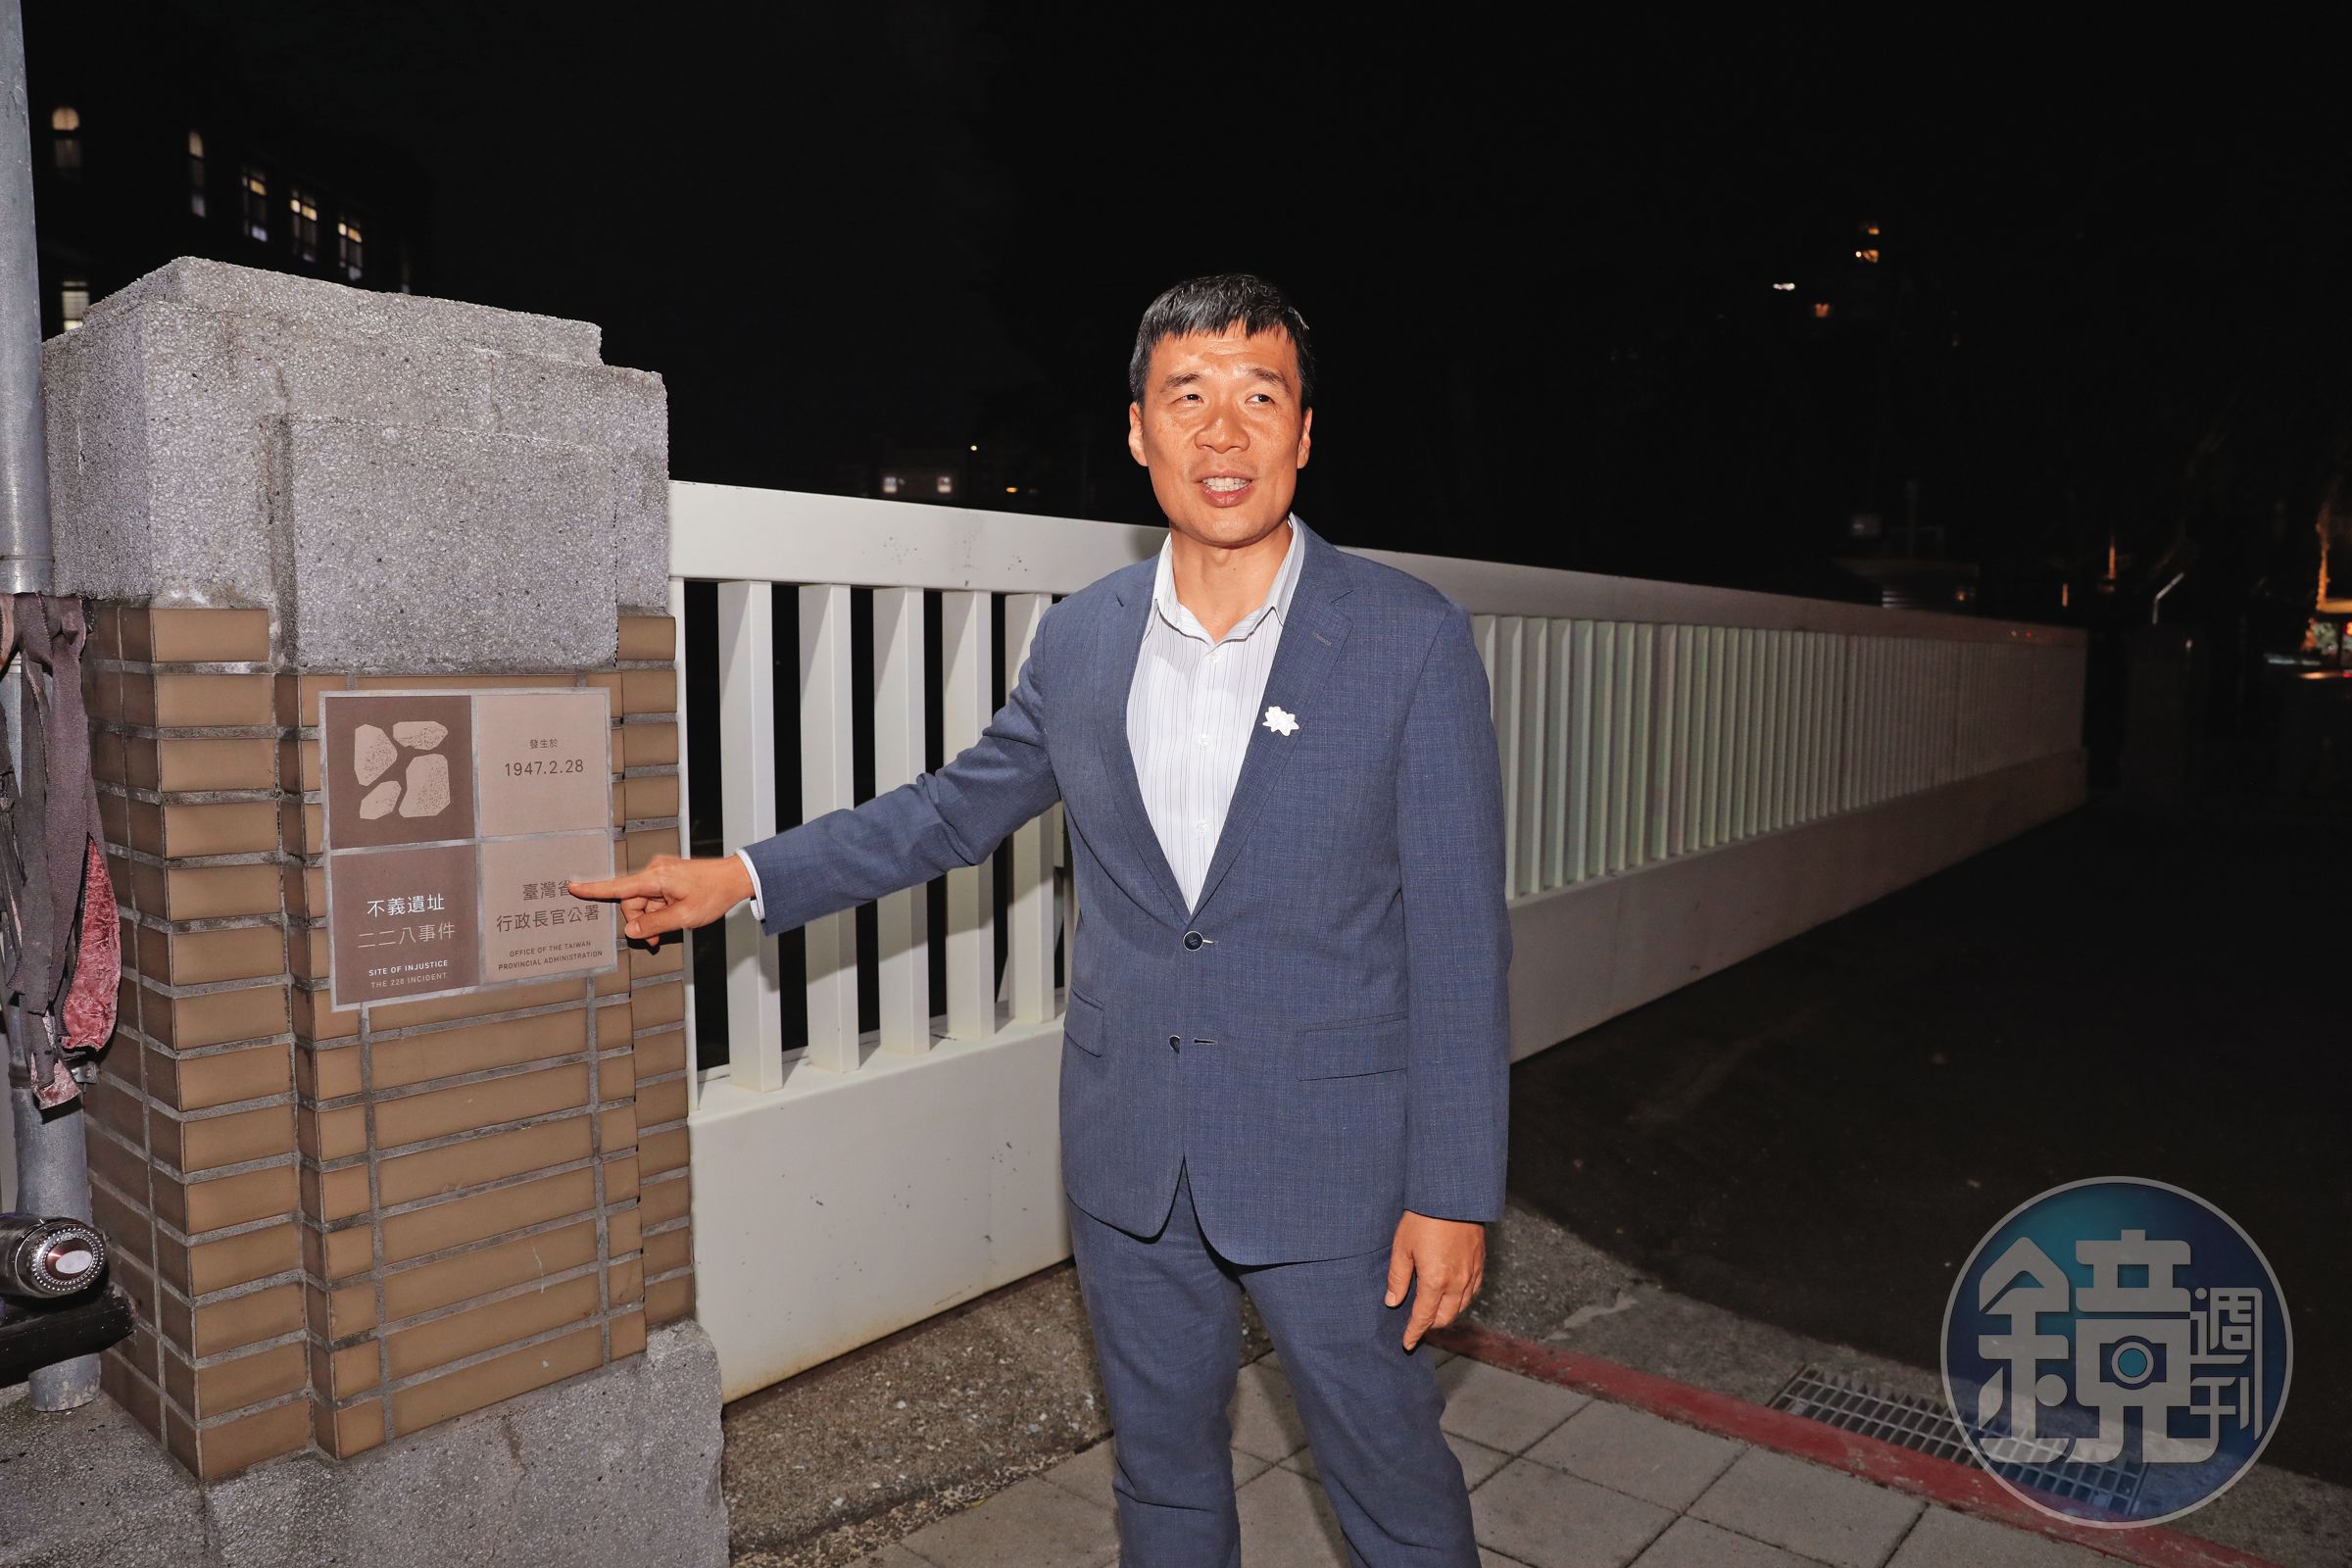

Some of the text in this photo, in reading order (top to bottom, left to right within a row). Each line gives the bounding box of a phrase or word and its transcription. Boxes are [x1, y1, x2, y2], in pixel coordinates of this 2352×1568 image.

[505, 759, 584, 777] 1947.2.28
[367, 893, 446, 918] 不義遺址
[496, 904, 600, 933] 行政長官公署
[357, 921, 456, 949] 二二八事件
[510, 948, 535, 957] OFFICE
[564, 941, 592, 950] TAIWAN
[368, 959, 448, 977] SITE OF INJUSTICE
[498, 950, 603, 971] PROVINCIAL ADMINISTRATION
[370, 971, 448, 989] THE 228 INCIDENT
